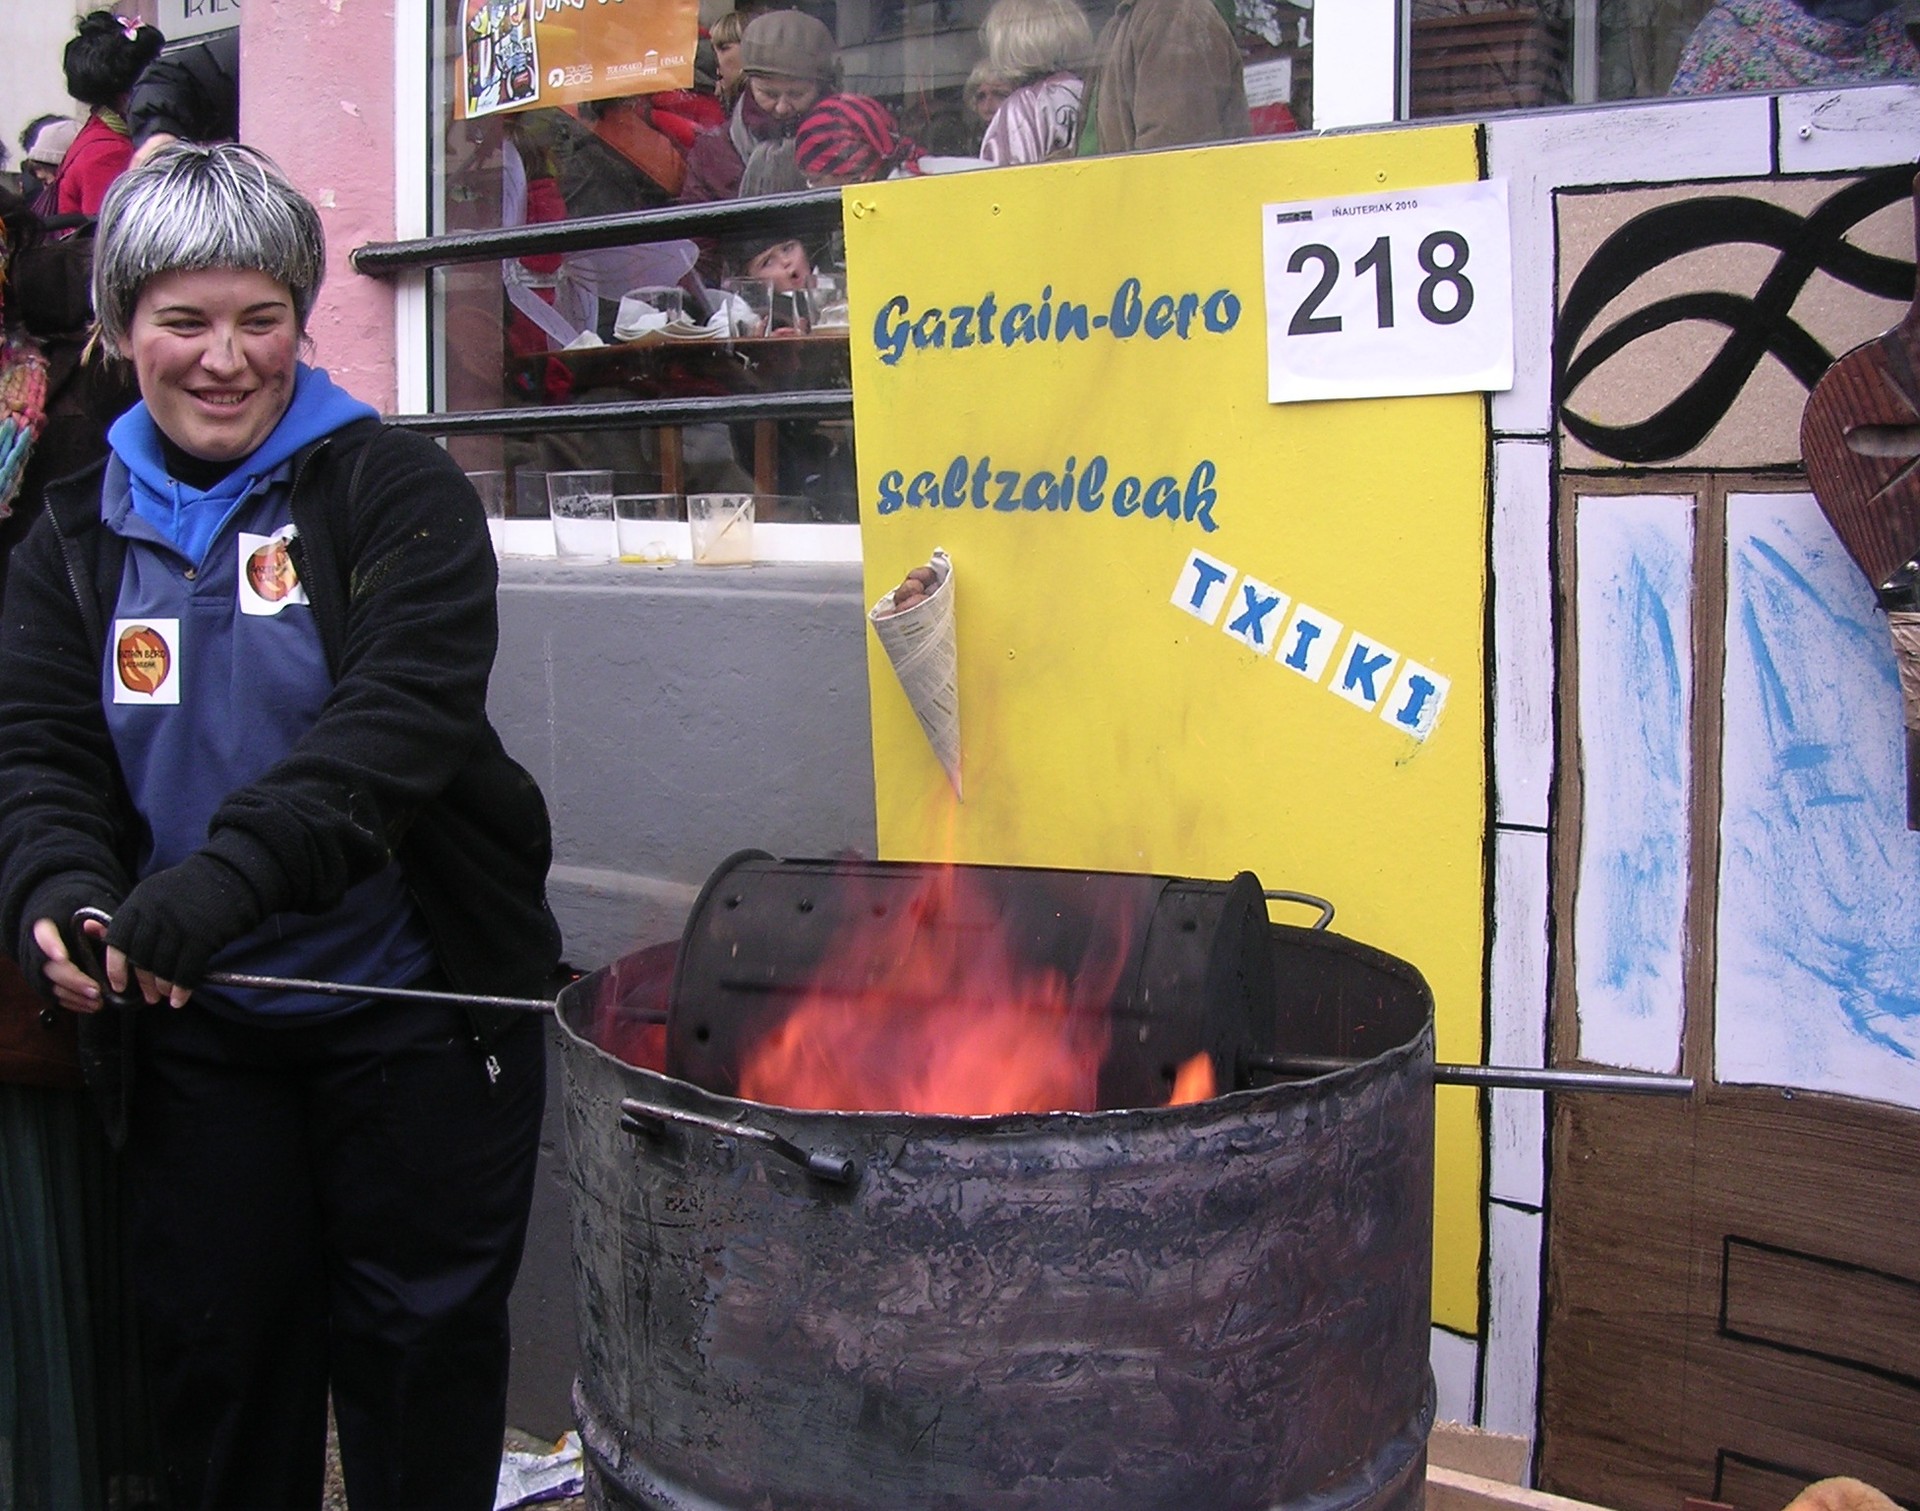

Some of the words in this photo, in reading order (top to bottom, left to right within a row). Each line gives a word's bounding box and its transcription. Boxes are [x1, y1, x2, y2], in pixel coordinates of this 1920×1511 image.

[1331, 203, 1393, 217] IÑAUTERIAK
[1395, 200, 1418, 212] 2010
[873, 277, 1242, 366] Gaztain-bero
[1286, 230, 1475, 337] 218
[1190, 557, 1436, 728] TXIKI
